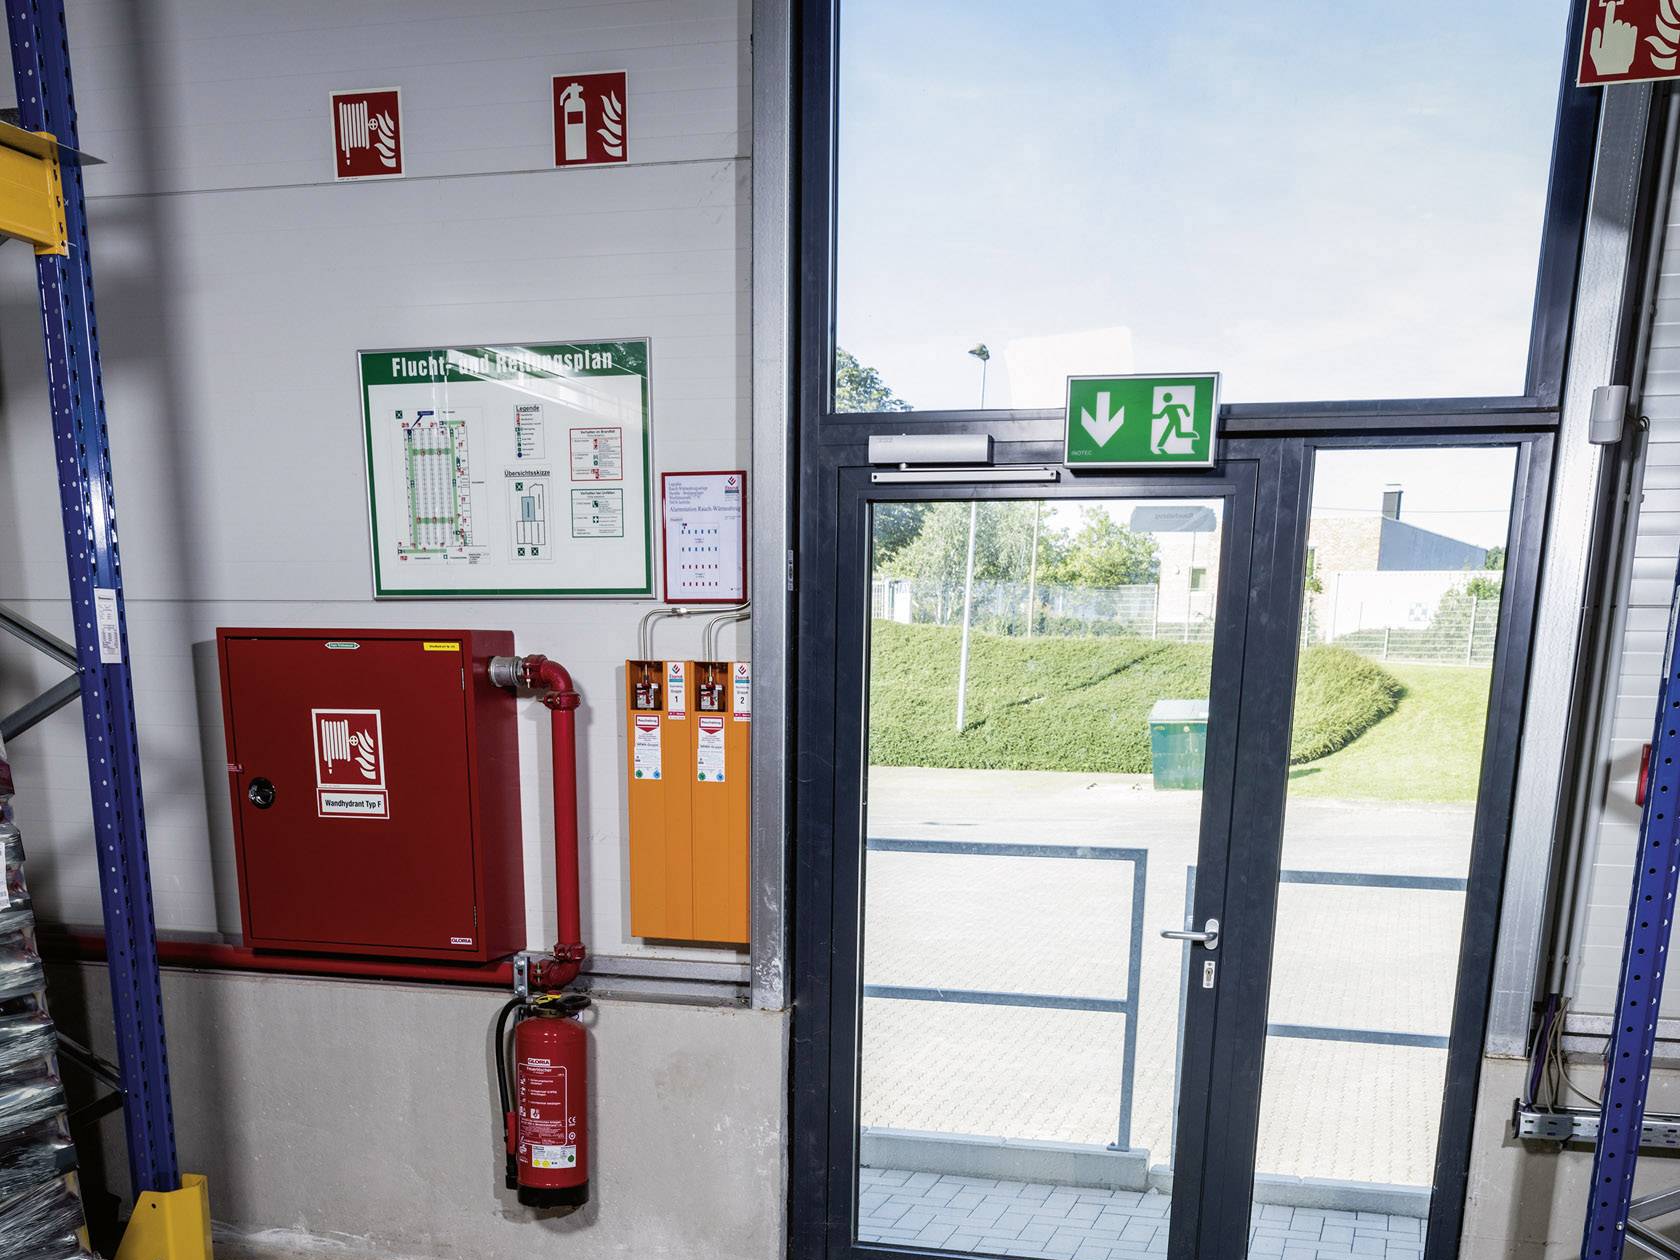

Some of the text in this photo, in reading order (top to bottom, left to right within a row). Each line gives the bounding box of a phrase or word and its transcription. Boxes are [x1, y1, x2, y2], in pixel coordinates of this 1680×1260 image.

[392, 350, 613, 378] Flucht- und Rettungsplan
[504, 469, 551, 477] Übersichtsskizze
[325, 799, 364, 809] Wandhydrant
[366, 801, 376, 809] Typ
[568, 1116, 576, 1124] CE
